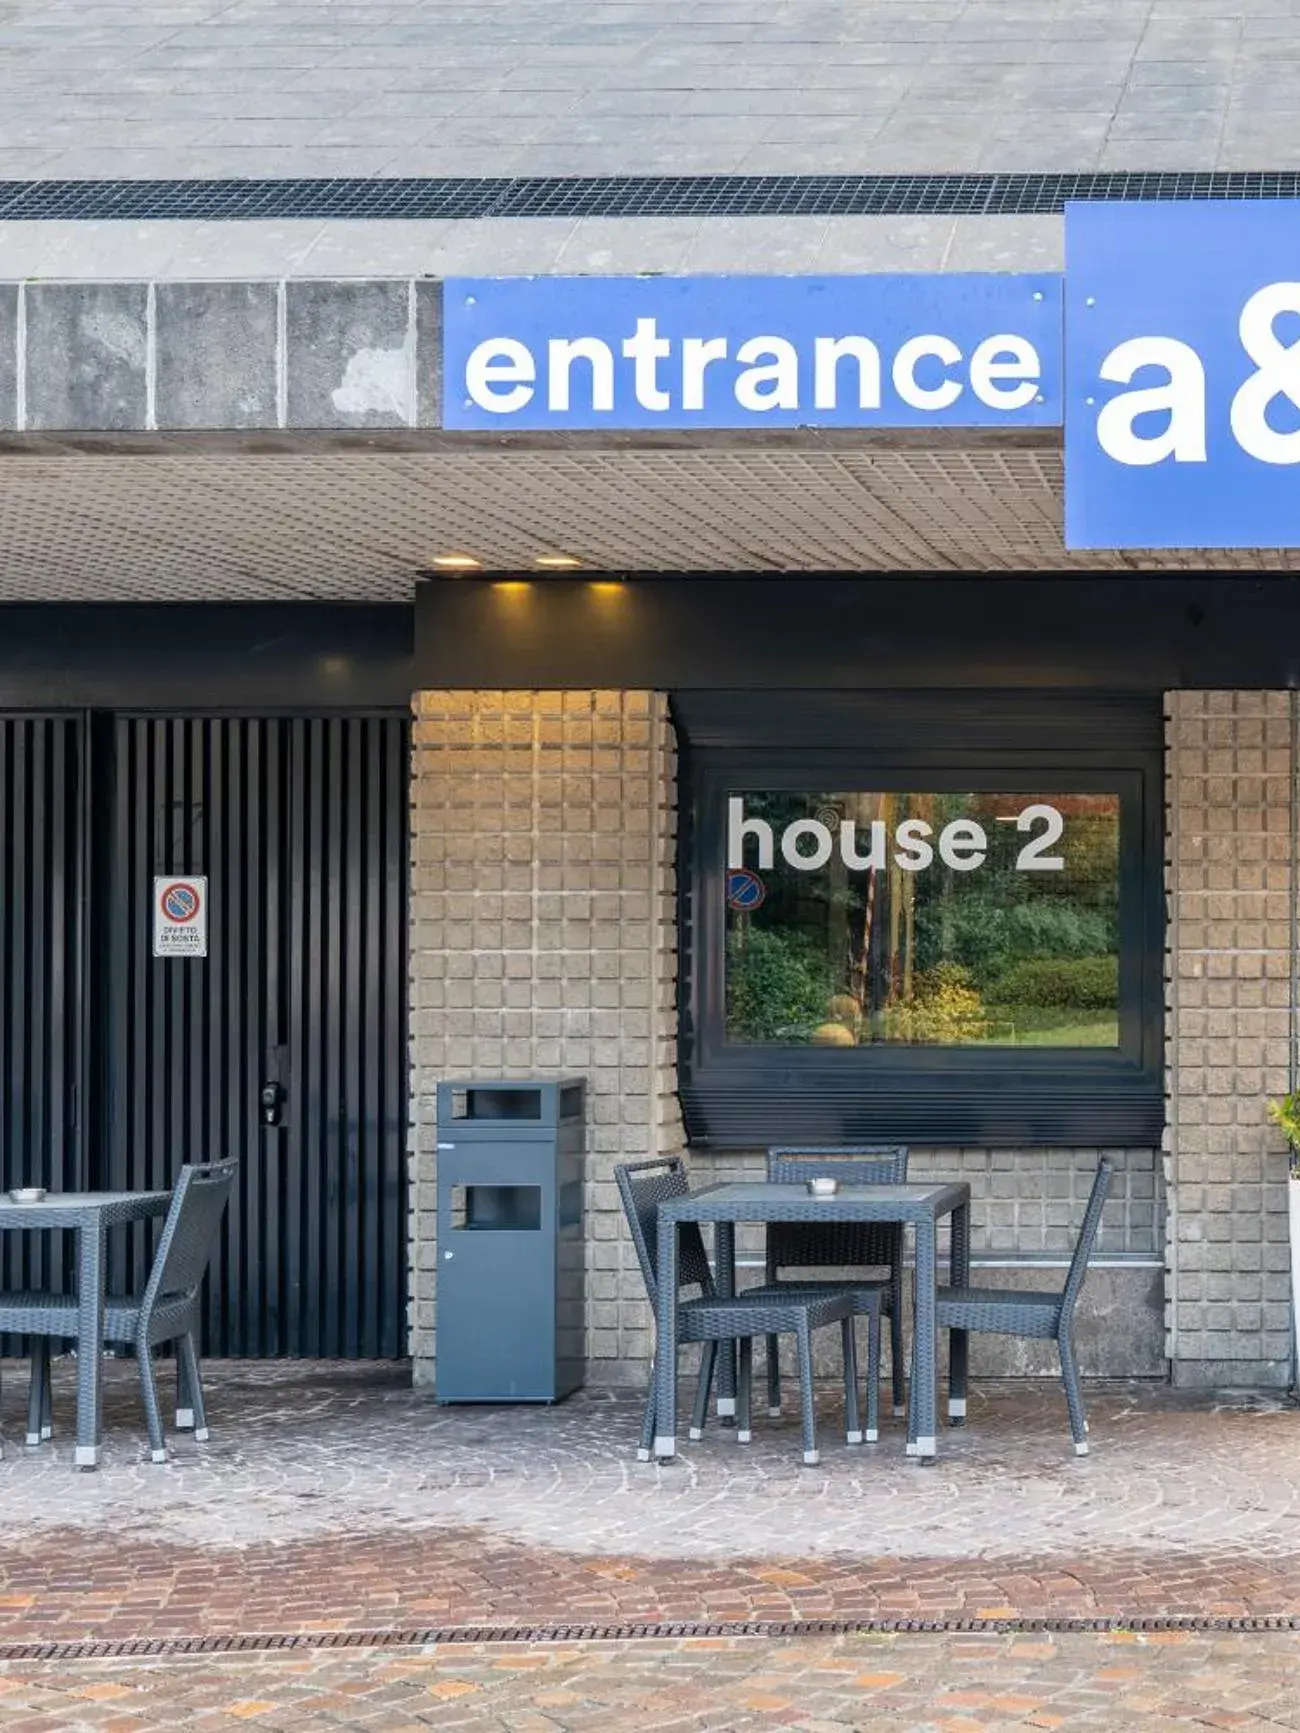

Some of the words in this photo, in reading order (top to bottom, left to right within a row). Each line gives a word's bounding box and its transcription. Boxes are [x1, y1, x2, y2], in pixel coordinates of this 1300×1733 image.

[465, 318, 1041, 413] entrance
[728, 797, 987, 871] house
[1015, 804, 1065, 871] 2
